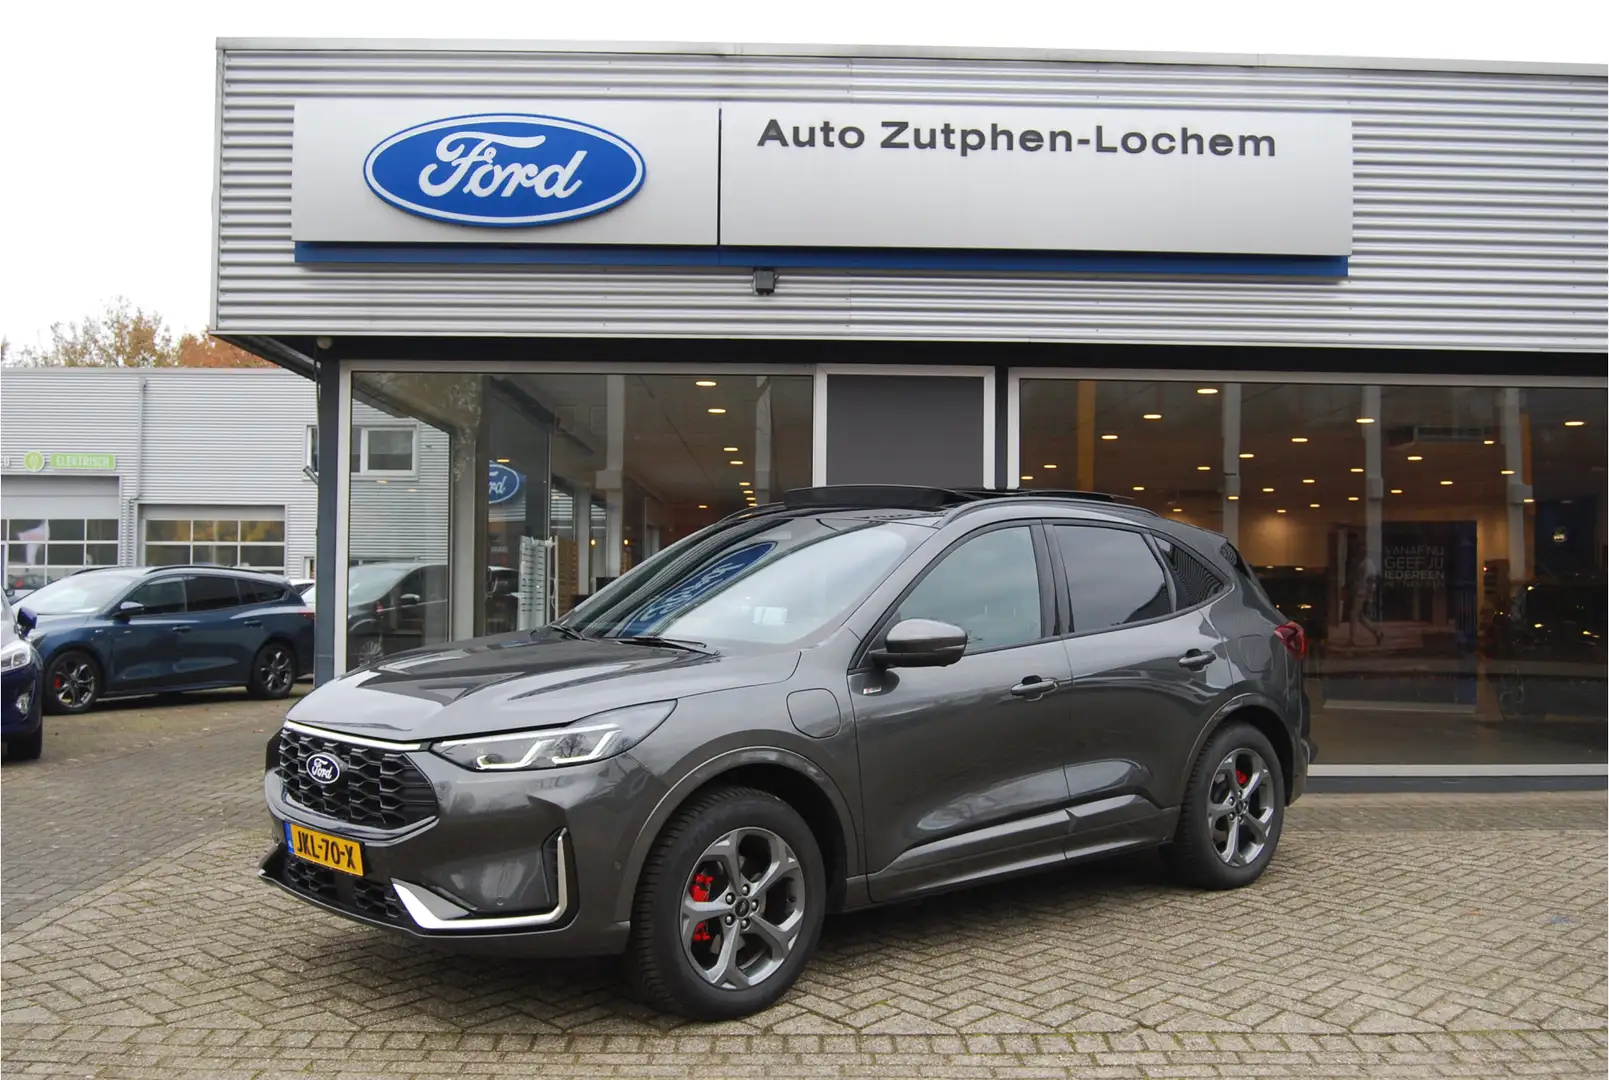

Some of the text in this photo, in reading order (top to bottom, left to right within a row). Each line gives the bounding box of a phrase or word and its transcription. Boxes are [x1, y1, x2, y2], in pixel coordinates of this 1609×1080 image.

[756, 119, 1277, 158] Auto Zutphen-Lochem
[418, 130, 588, 198] Ford
[1384, 556, 1426, 569] GEEF
[1384, 569, 1445, 580] IEDEREEN
[311, 757, 334, 780] Ford
[297, 831, 356, 869] JKL-70-X
